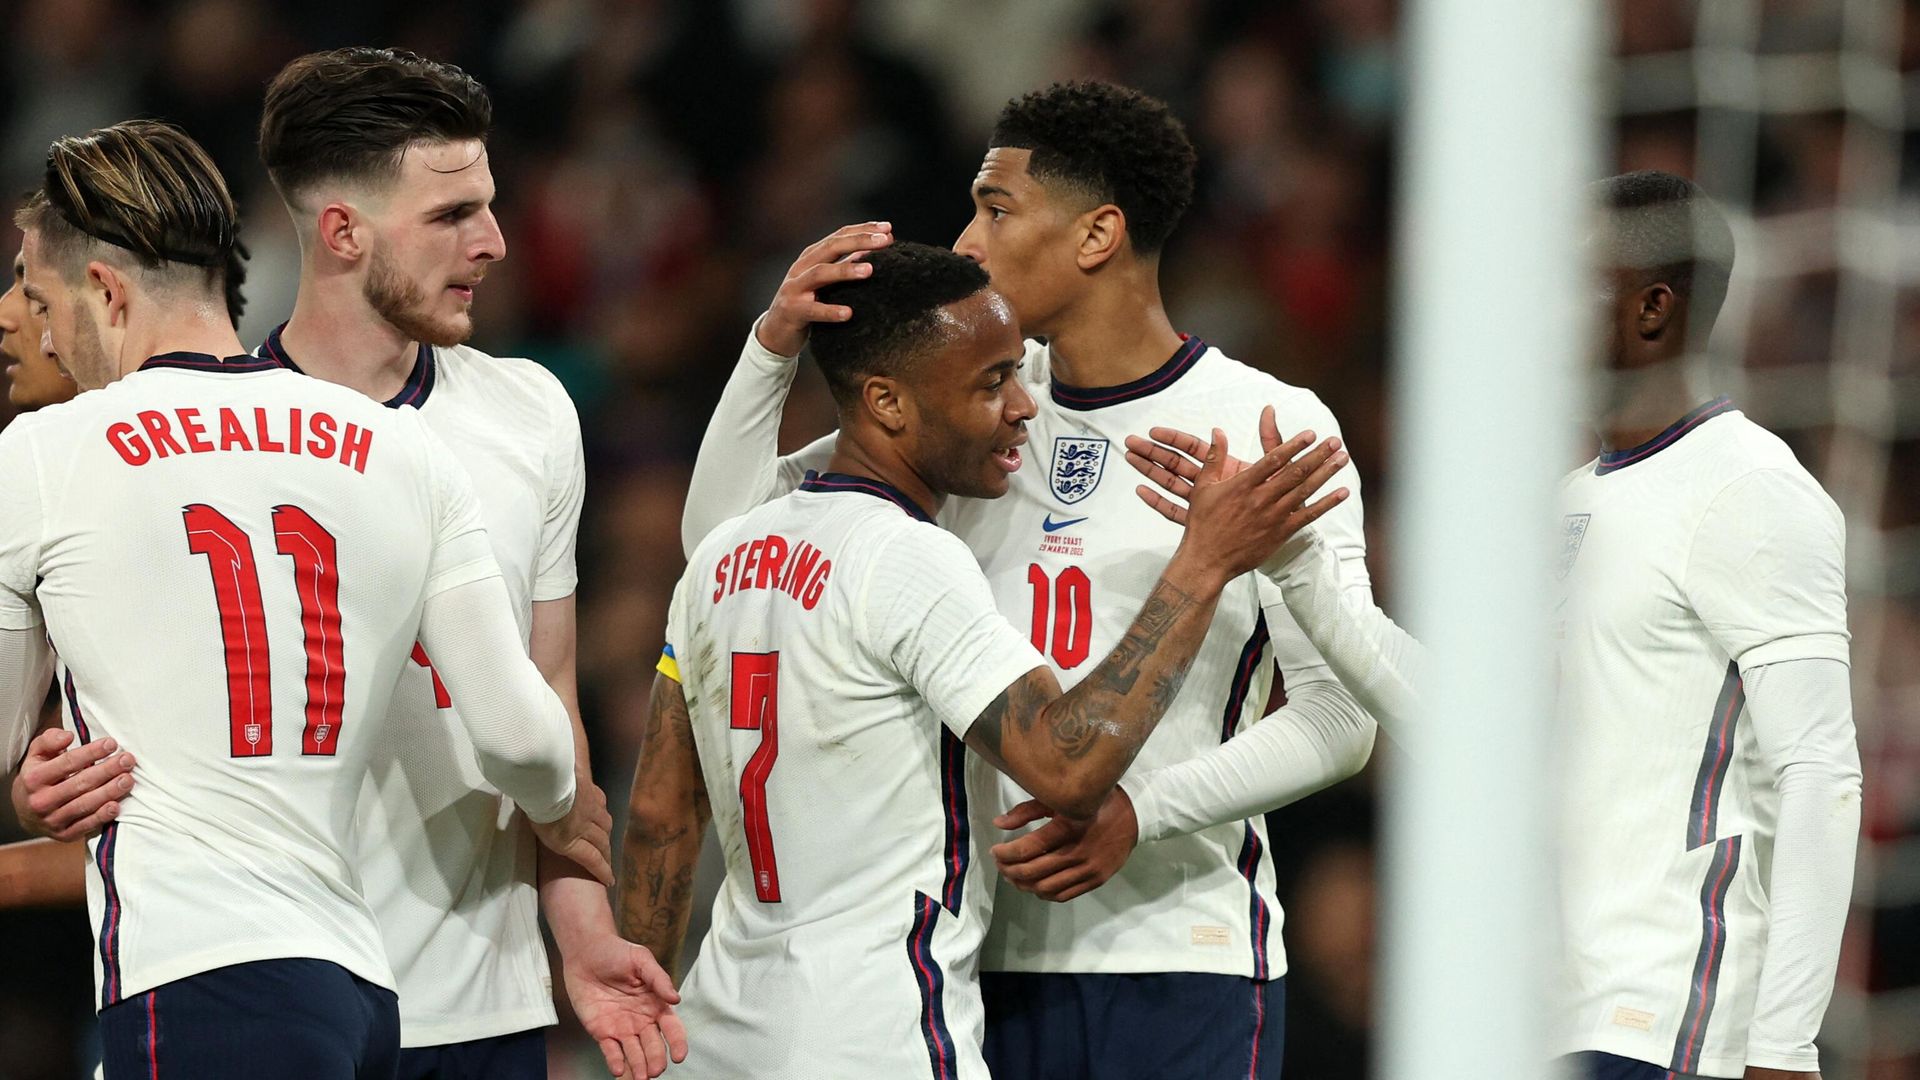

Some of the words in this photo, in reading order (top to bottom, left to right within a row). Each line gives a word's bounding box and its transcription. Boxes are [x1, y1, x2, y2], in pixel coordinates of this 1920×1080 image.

[106, 407, 373, 475] GREALISH
[713, 534, 832, 611] STERING
[1044, 535, 1061, 543] IVORY
[1063, 537, 1082, 545] COAST
[1047, 545, 1069, 554] MARCH
[182, 503, 346, 758] 11
[1028, 562, 1093, 670] 10
[730, 650, 782, 903] 7
